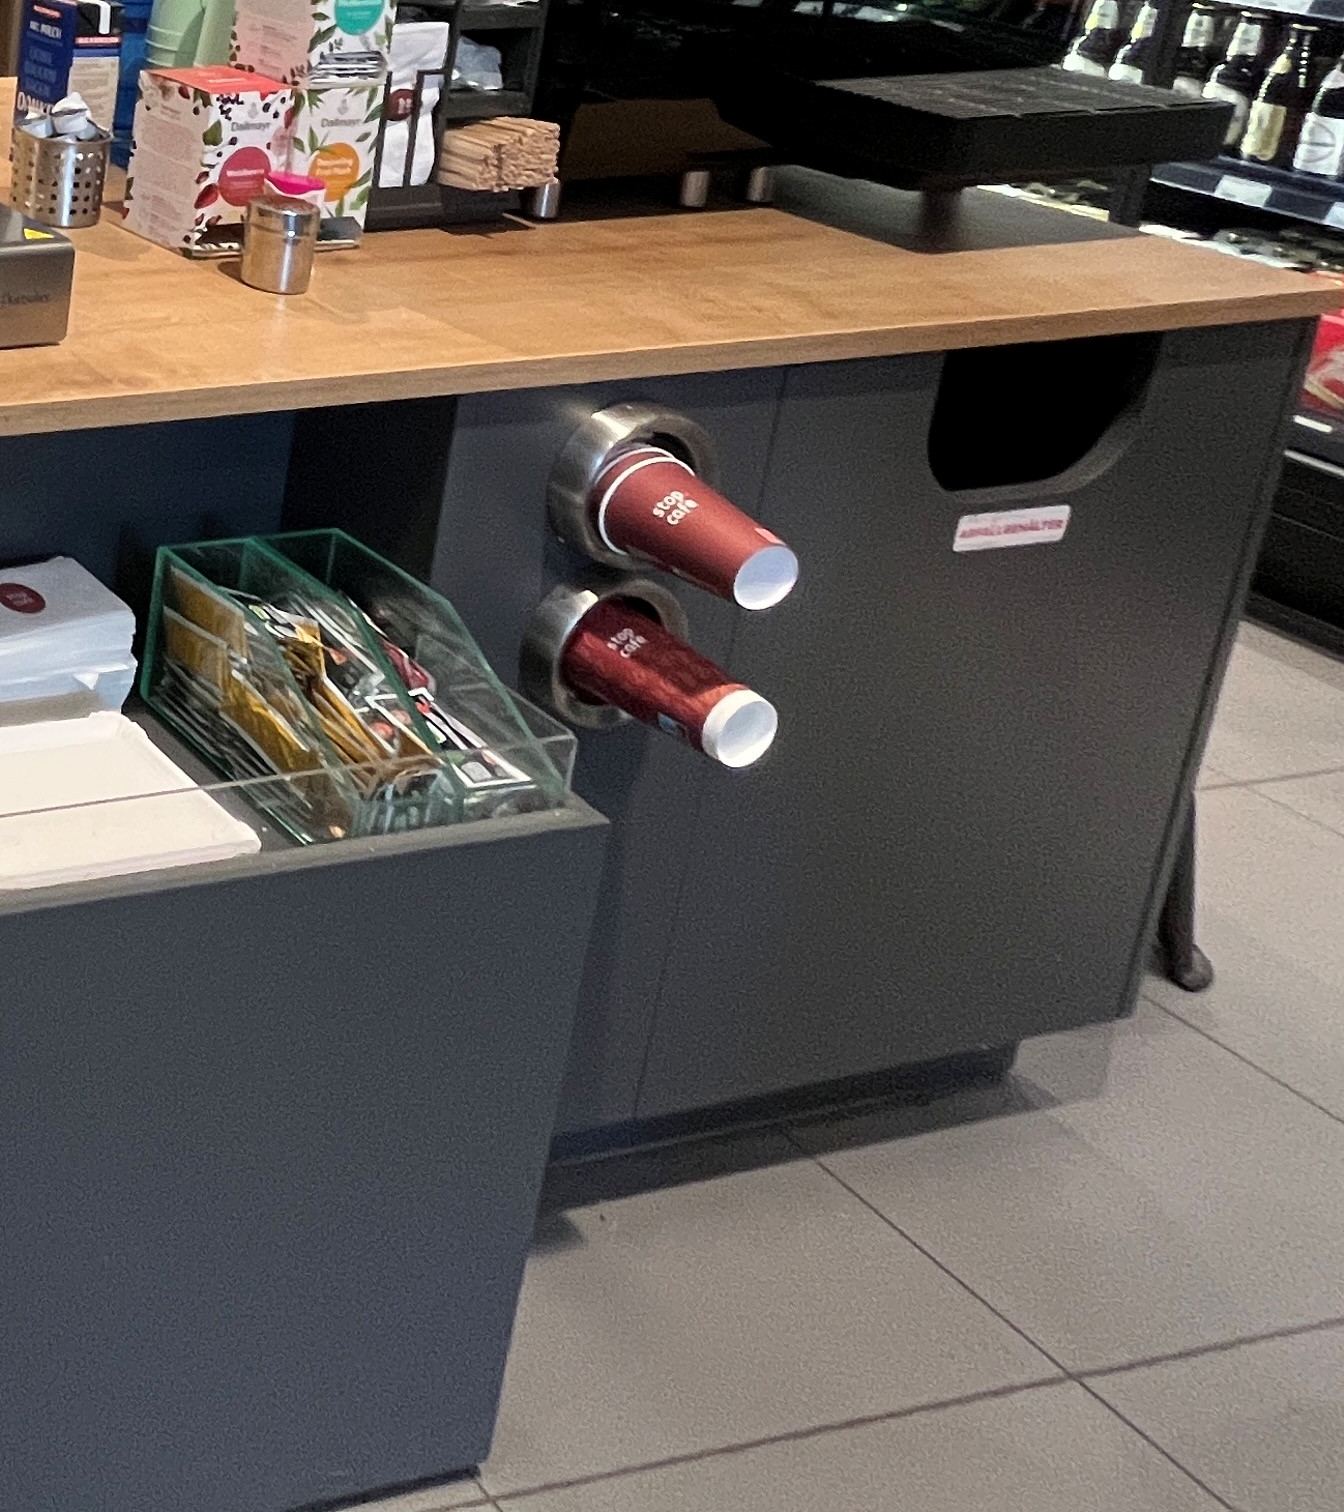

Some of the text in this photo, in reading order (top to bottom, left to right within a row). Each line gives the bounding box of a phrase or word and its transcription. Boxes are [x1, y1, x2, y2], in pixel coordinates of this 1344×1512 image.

[230, 121, 271, 133] Dallmayr
[320, 117, 363, 128] Dallmayr
[652, 490, 684, 518] stop
[666, 499, 699, 526] cafe
[606, 627, 635, 651] stop
[619, 635, 648, 659] cafe
